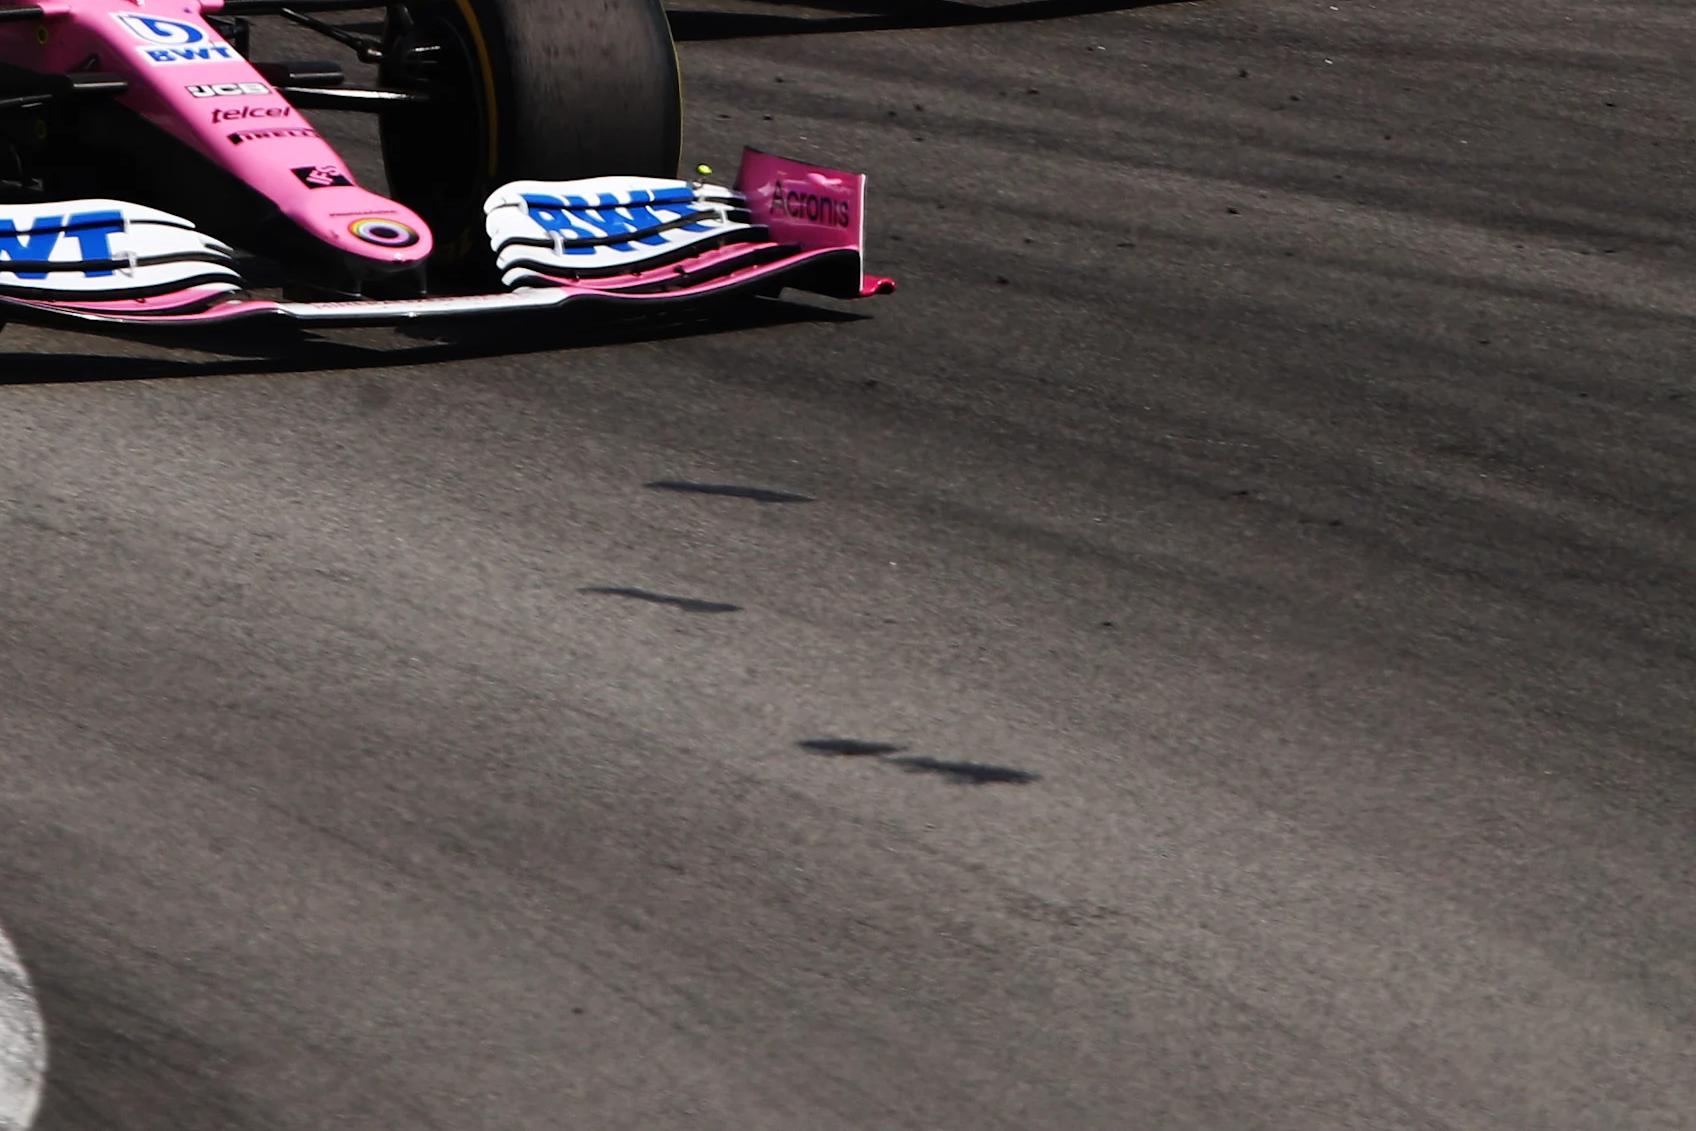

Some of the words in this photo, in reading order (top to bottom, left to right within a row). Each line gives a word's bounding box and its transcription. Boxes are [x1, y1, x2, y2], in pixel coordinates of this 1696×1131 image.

[145, 45, 233, 62] BWT
[186, 82, 272, 98] JCB
[212, 106, 290, 123] telcel
[769, 179, 850, 228] Acronis
